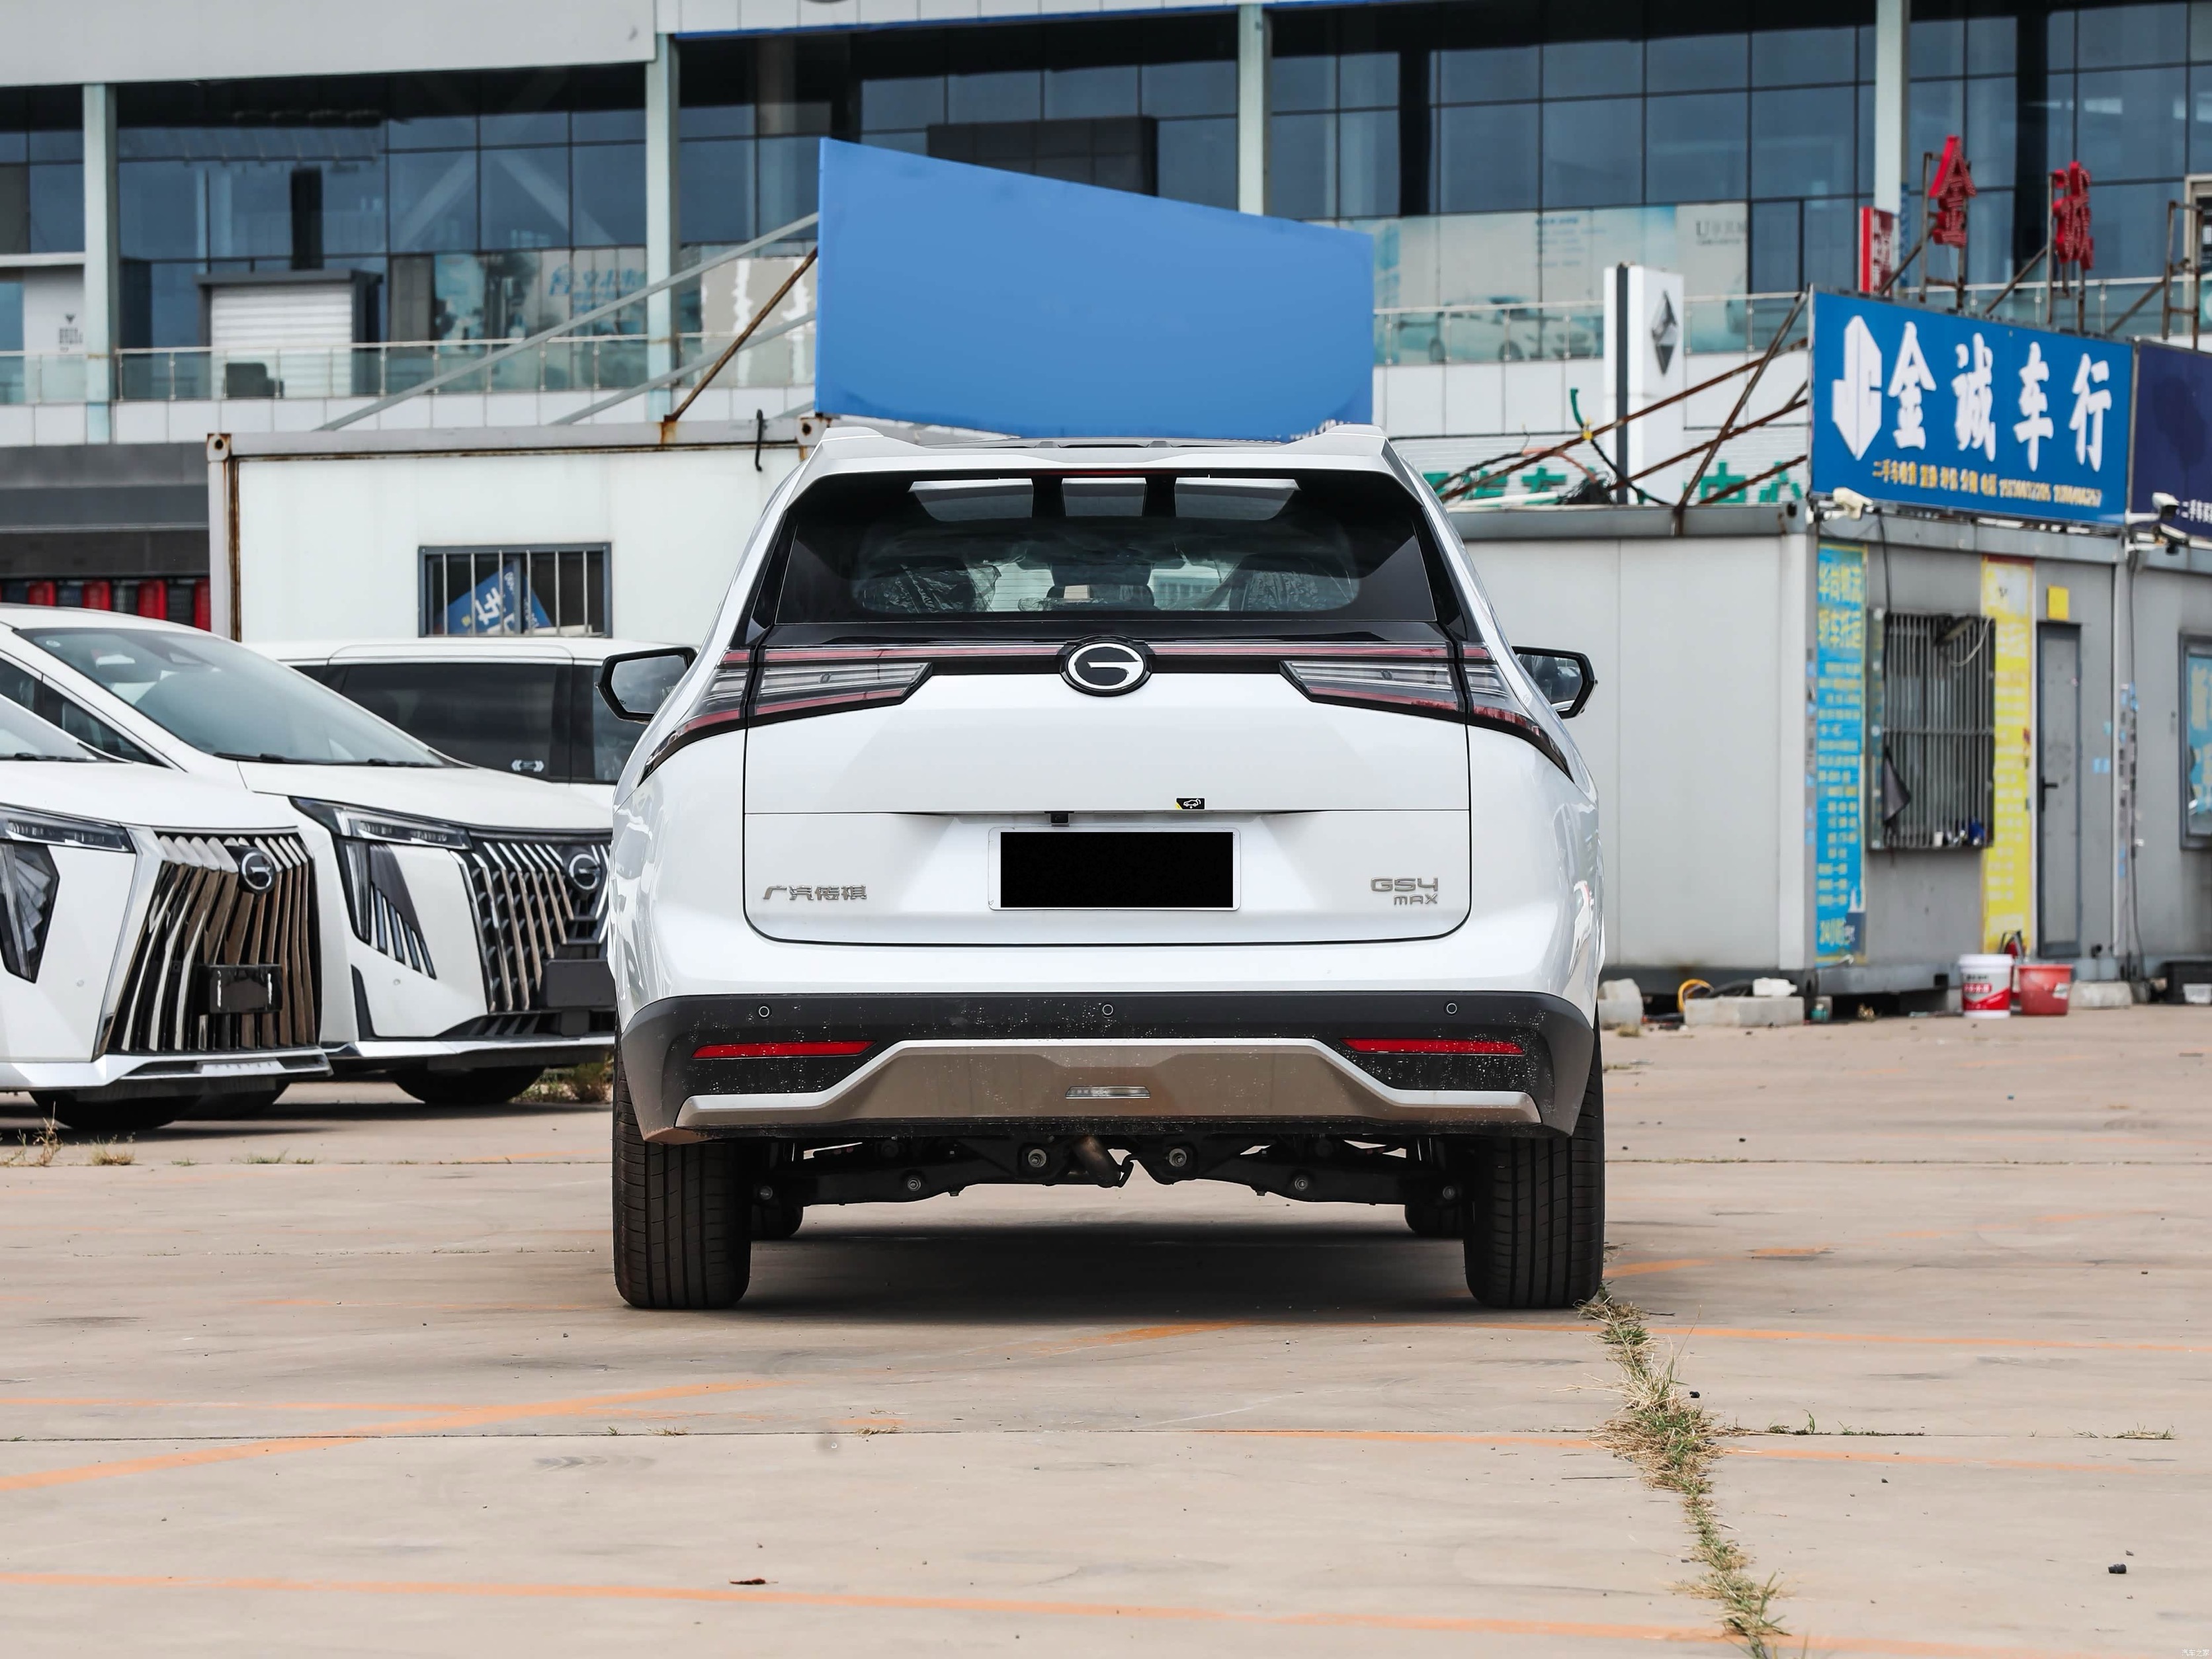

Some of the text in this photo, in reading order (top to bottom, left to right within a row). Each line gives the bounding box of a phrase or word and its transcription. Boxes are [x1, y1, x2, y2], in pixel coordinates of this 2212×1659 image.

[1889, 321, 2112, 473] 金诚车行
[763, 884, 867, 900] 广汽传祺
[1371, 876, 1438, 892] GS4
[1393, 893, 1437, 906] MAX
